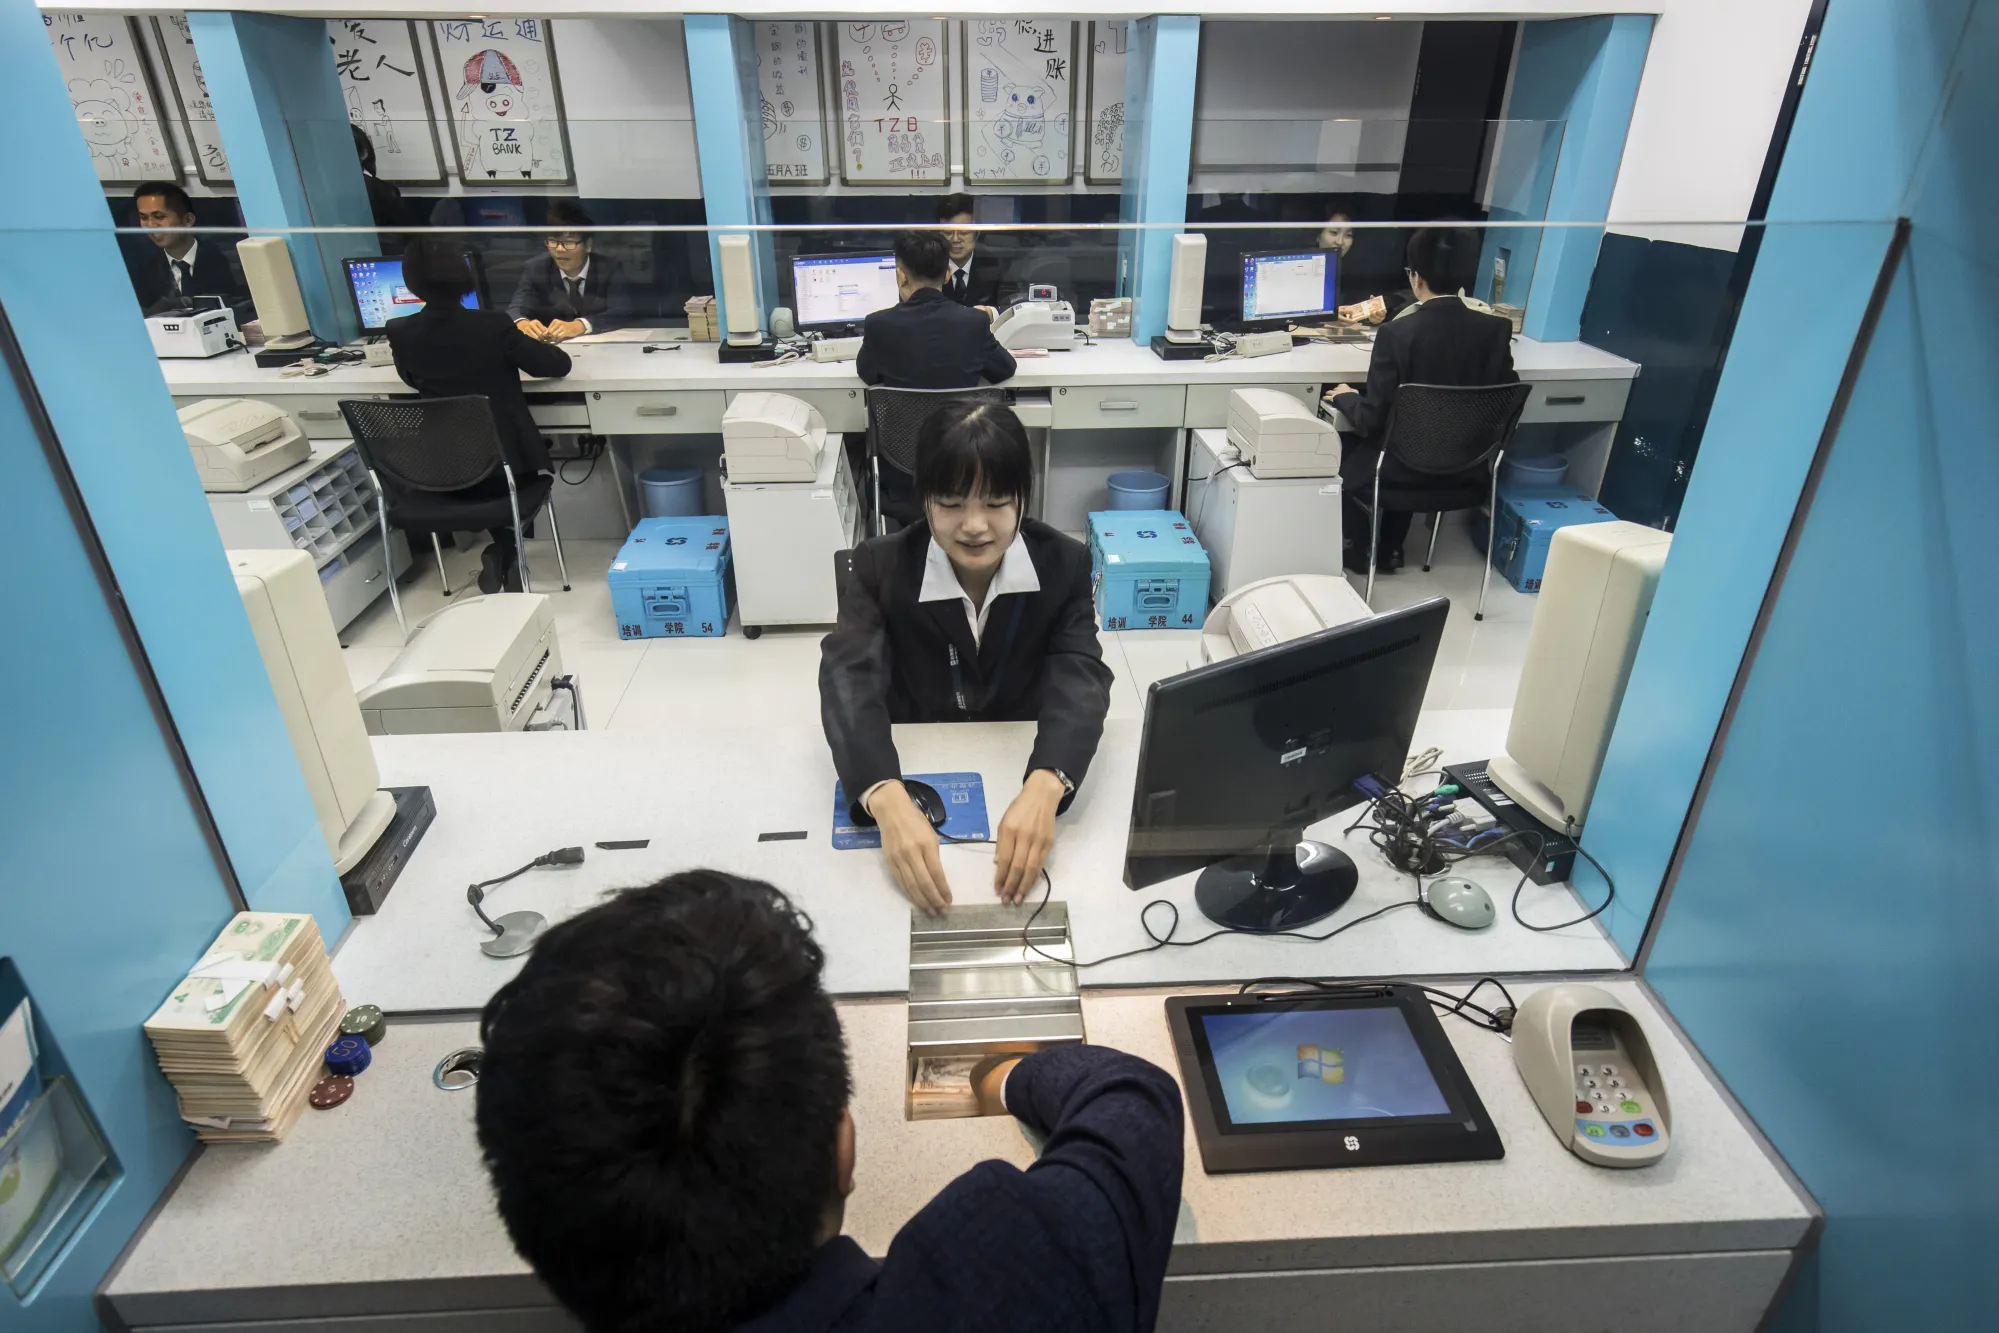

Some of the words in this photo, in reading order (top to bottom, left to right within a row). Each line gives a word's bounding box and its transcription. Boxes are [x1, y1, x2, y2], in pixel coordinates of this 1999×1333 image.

[336, 48, 415, 81] 老人
[873, 116, 918, 133] TZB
[489, 127, 518, 142] TZ
[492, 142, 523, 155] BANK
[621, 623, 643, 638] 培训
[664, 621, 685, 635] 学院
[701, 622, 714, 634] 54
[1107, 616, 1127, 630] 培训
[1148, 615, 1167, 628] 学院
[1181, 613, 1193, 625] 44
[355, 1015, 368, 1024] 10
[331, 1039, 358, 1057] 50
